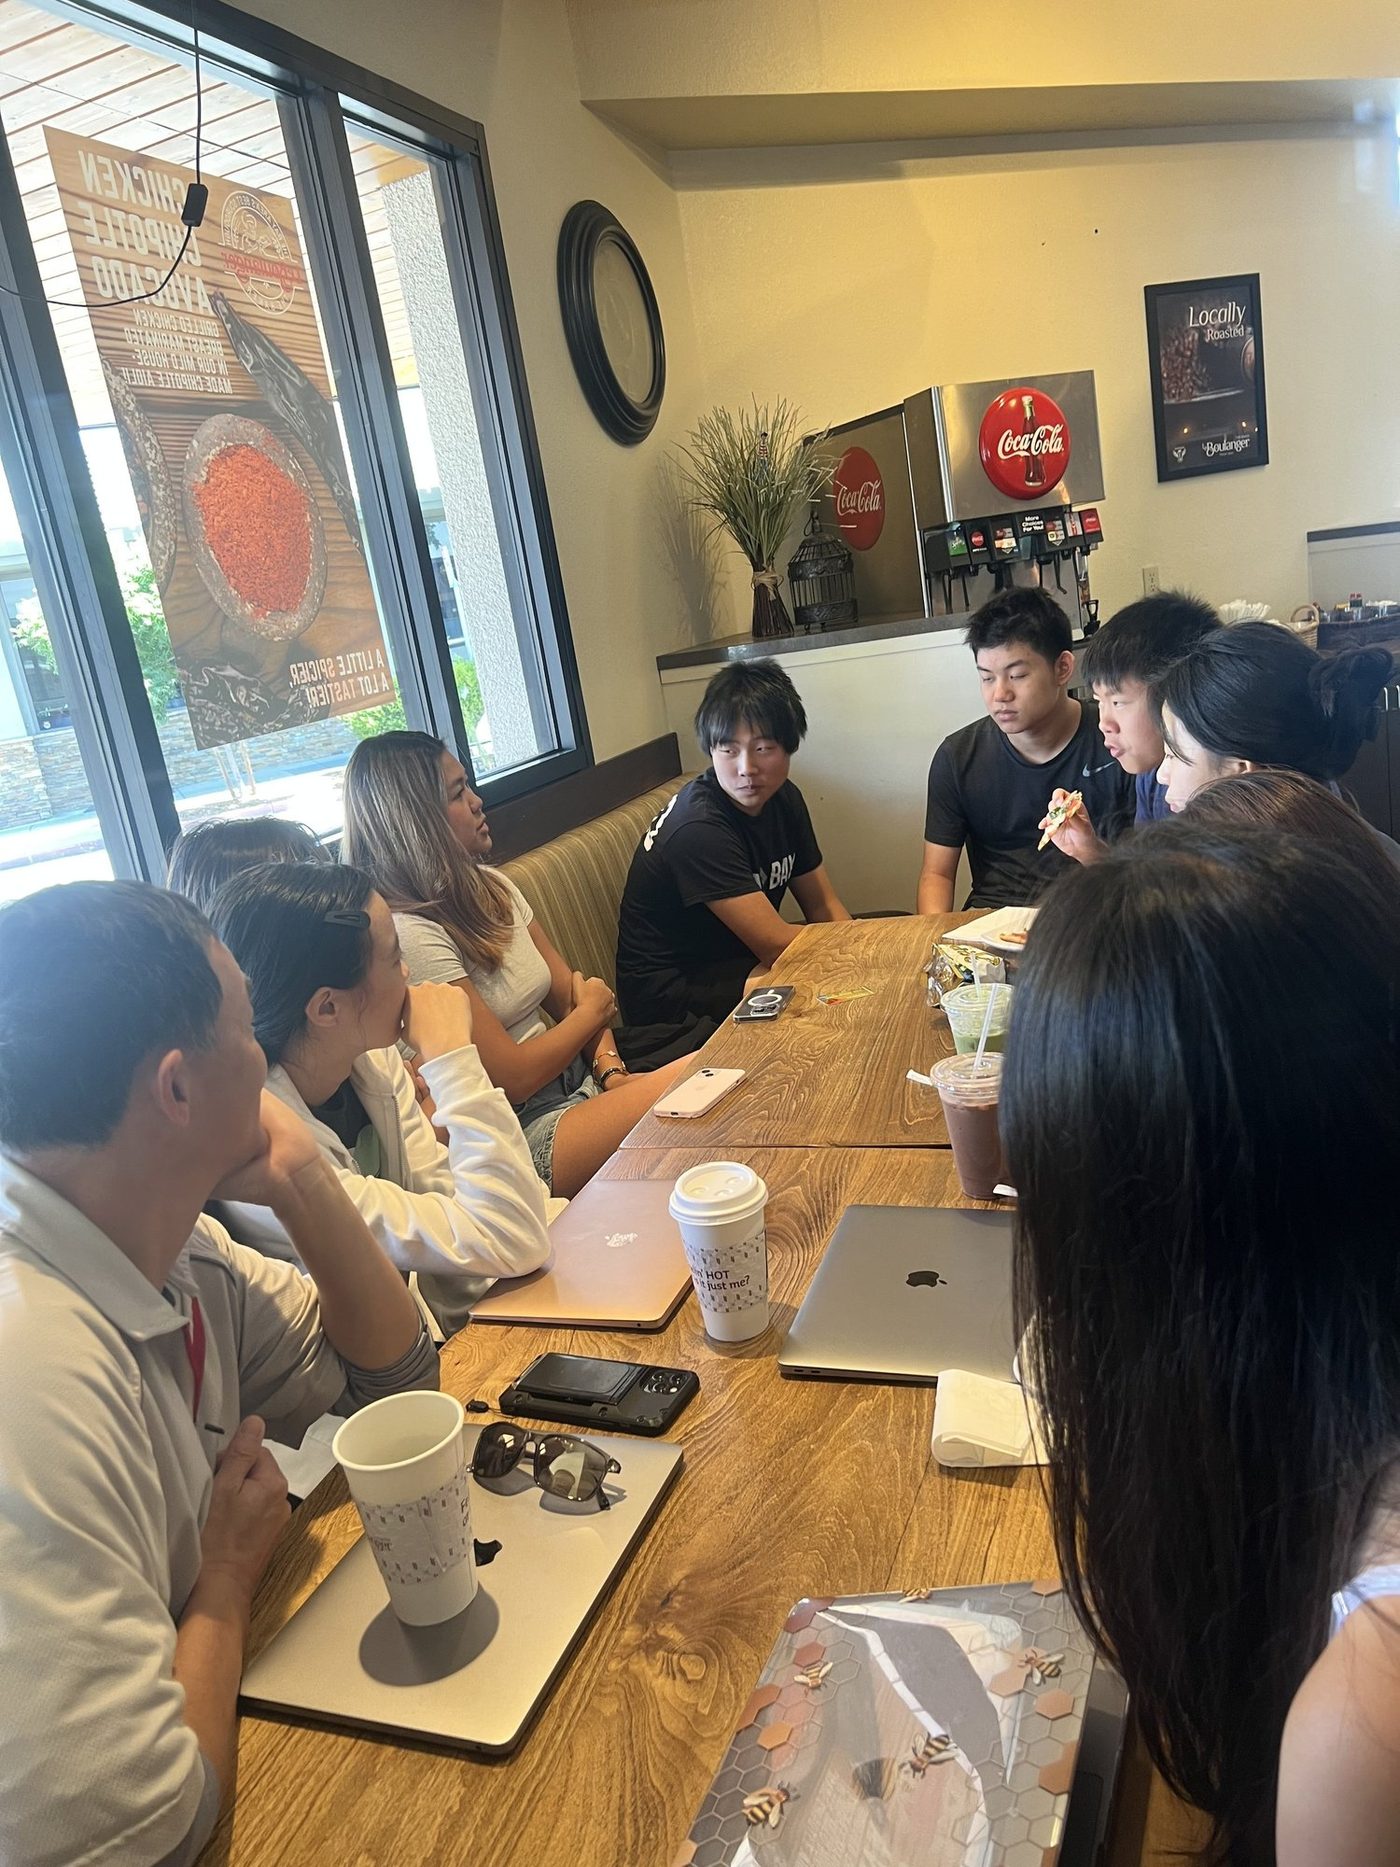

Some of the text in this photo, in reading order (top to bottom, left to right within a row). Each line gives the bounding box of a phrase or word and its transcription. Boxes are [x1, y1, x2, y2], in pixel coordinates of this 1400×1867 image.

[1189, 302, 1246, 327] Locally
[1207, 325, 1245, 342] Roasted
[998, 424, 1065, 460] Coca-Cola
[1206, 432, 1250, 457] Boulanger
[769, 852, 796, 890] BAY
[705, 1270, 730, 1280] HOT
[707, 1281, 727, 1291] just
[729, 1274, 750, 1289] me?
